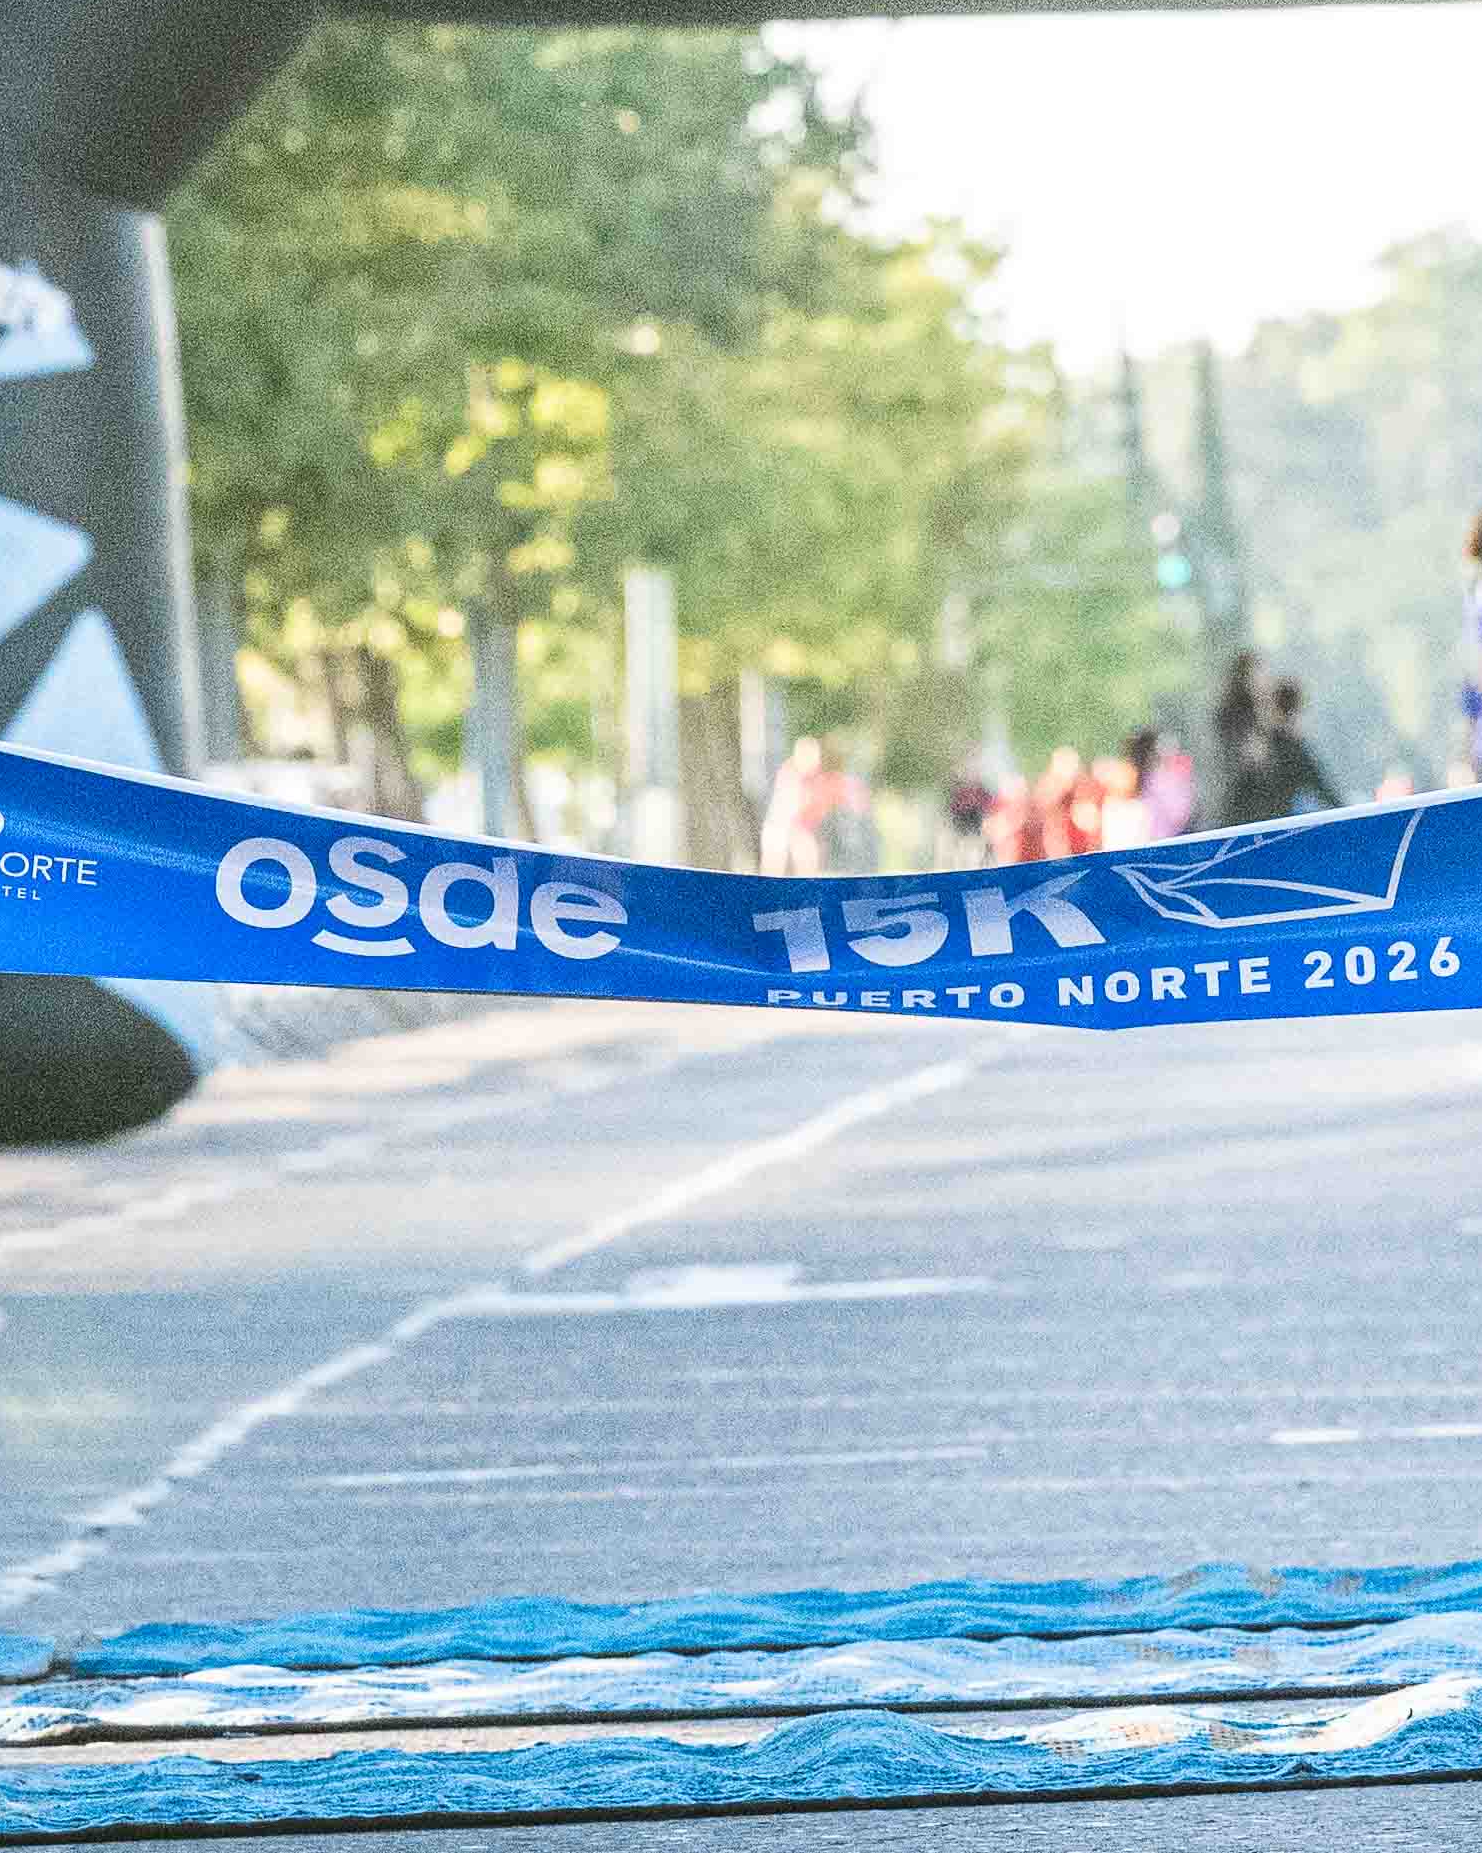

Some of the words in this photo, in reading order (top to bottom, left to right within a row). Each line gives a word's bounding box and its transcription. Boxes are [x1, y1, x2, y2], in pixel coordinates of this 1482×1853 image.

[752, 868, 1108, 974] 15K
[766, 982, 1025, 1010] PUERTO
[1058, 956, 1271, 1007] NORTE
[1303, 936, 1462, 989] 2026
